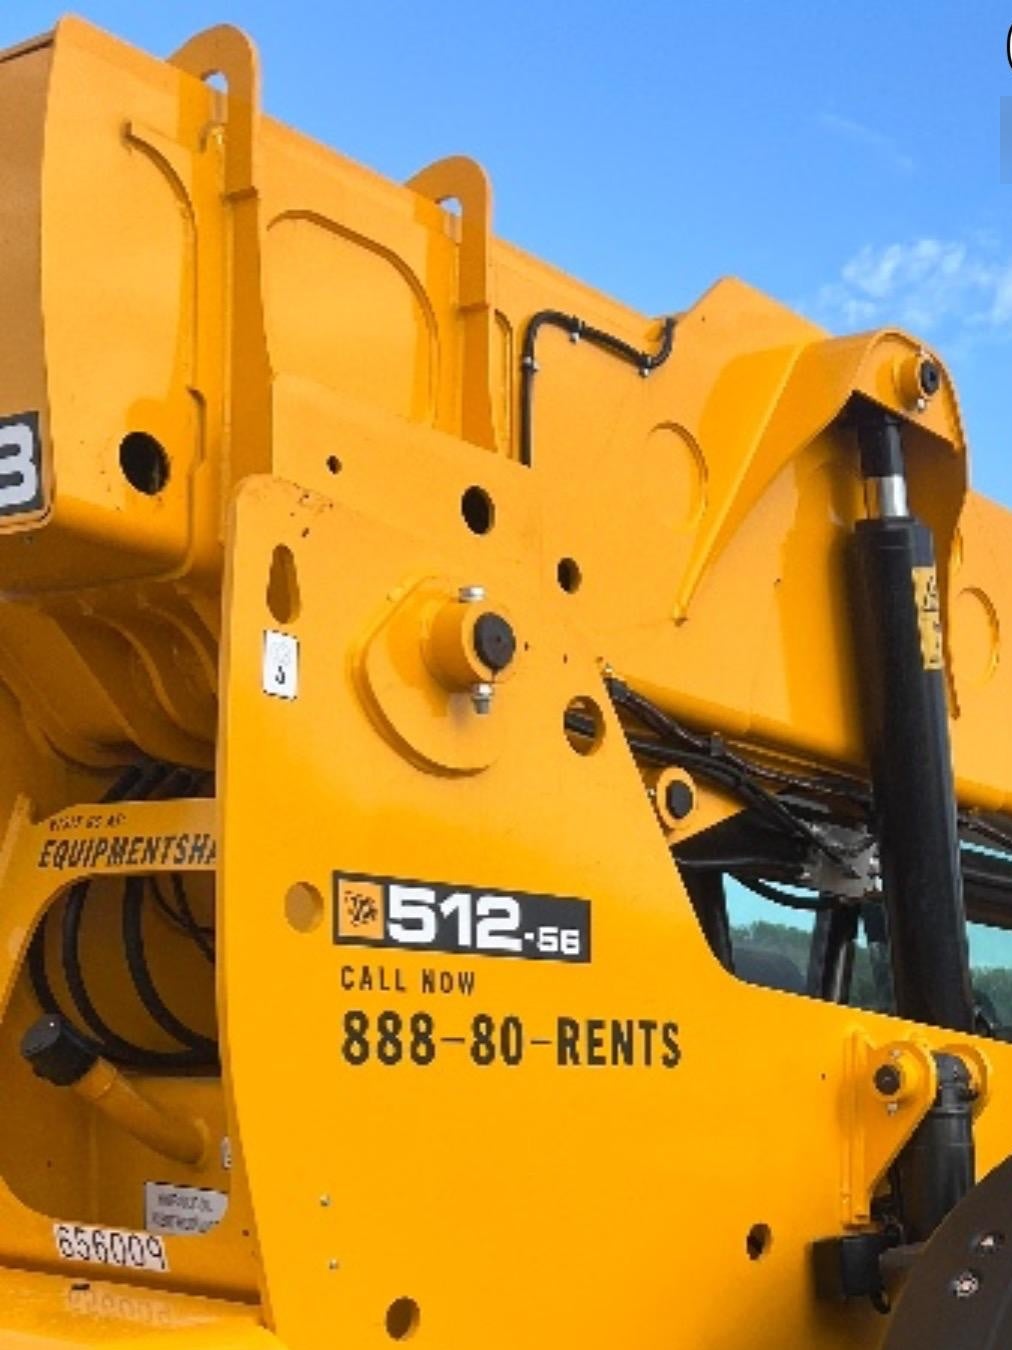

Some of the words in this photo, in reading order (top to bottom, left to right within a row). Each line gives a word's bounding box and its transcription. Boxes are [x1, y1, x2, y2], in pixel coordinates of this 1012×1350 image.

[340, 965, 406, 992] CALL
[421, 968, 476, 996] NOW
[341, 1009, 682, 1070] 888-80-RENTS
[57, 1226, 166, 1270] 656009
